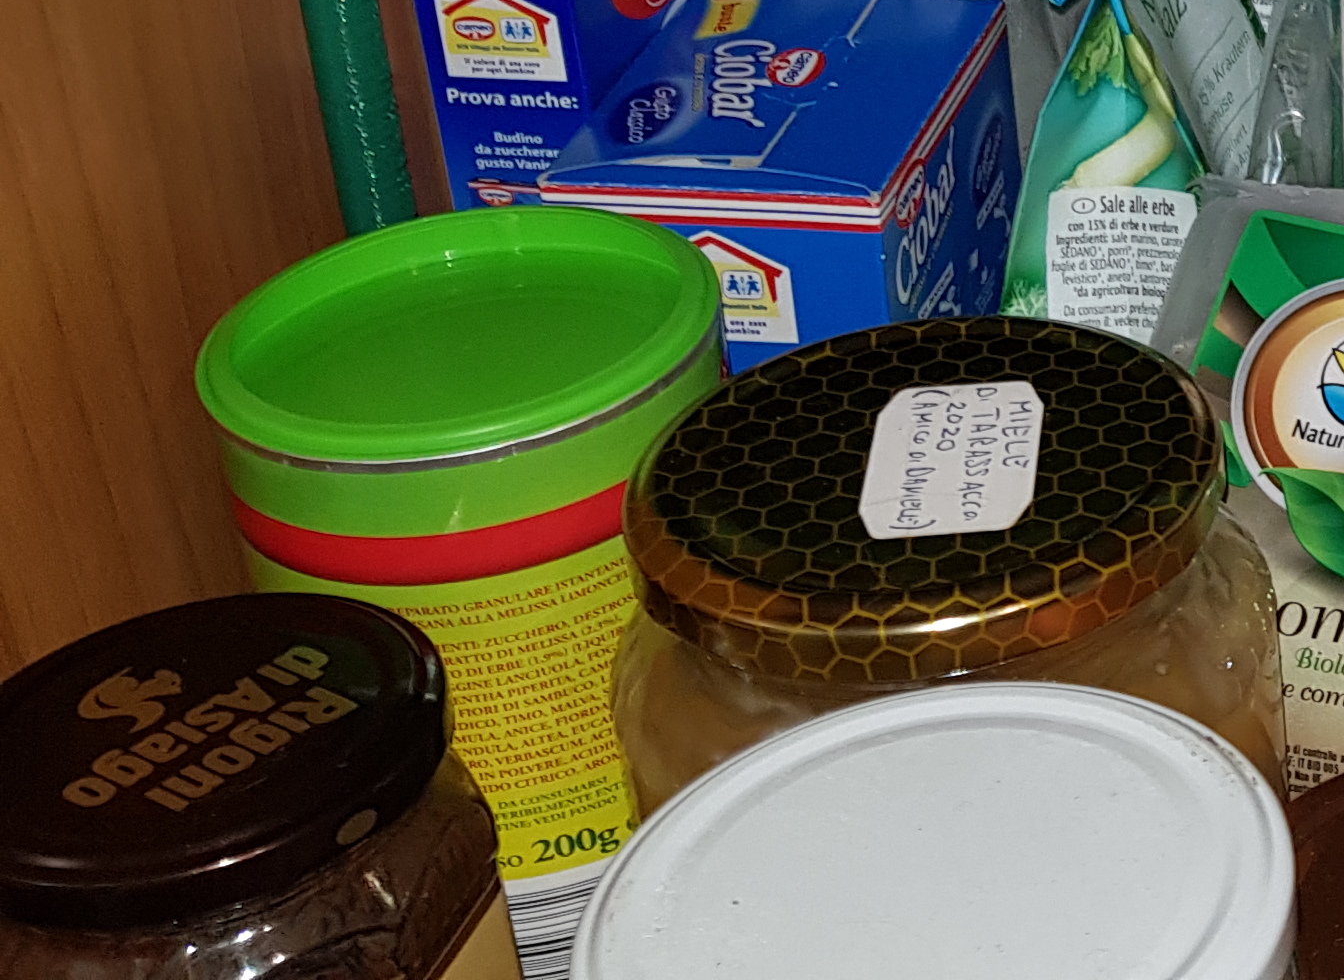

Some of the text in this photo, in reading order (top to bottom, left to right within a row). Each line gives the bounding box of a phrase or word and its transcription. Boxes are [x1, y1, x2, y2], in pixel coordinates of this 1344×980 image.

[782, 51, 813, 85] cameo
[711, 39, 777, 129] Ciobar
[446, 87, 580, 110] Prova anche:
[494, 131, 544, 144] Budino
[474, 143, 560, 159] da zuccherar
[476, 158, 515, 171] gusto
[1100, 194, 1176, 217] Sale alle erbe
[1068, 222, 1084, 232] con
[1088, 219, 1107, 231] 15%
[1109, 218, 1118, 231] di
[1121, 218, 1140, 231] erbe
[1148, 221, 1179, 235] verdure
[1111, 232, 1128, 244] sale
[1064, 304, 1076, 317] Da
[935, 402, 968, 452] 2020
[1001, 400, 1034, 469] MIELE
[463, 584, 552, 613] GRANULARE
[456, 596, 559, 627] ALLA MELISSA
[484, 620, 572, 649] ZUCCHERO,
[498, 630, 579, 661] DI MELISSA
[466, 666, 484, 679] DI
[458, 704, 500, 718] FIORI
[502, 700, 520, 713] DI
[144, 685, 359, 813] Rigoni
[478, 769, 496, 781] IN
[498, 775, 609, 810] DA CONSUMARSI
[570, 795, 619, 818] FONDO
[530, 827, 621, 864] 200g
